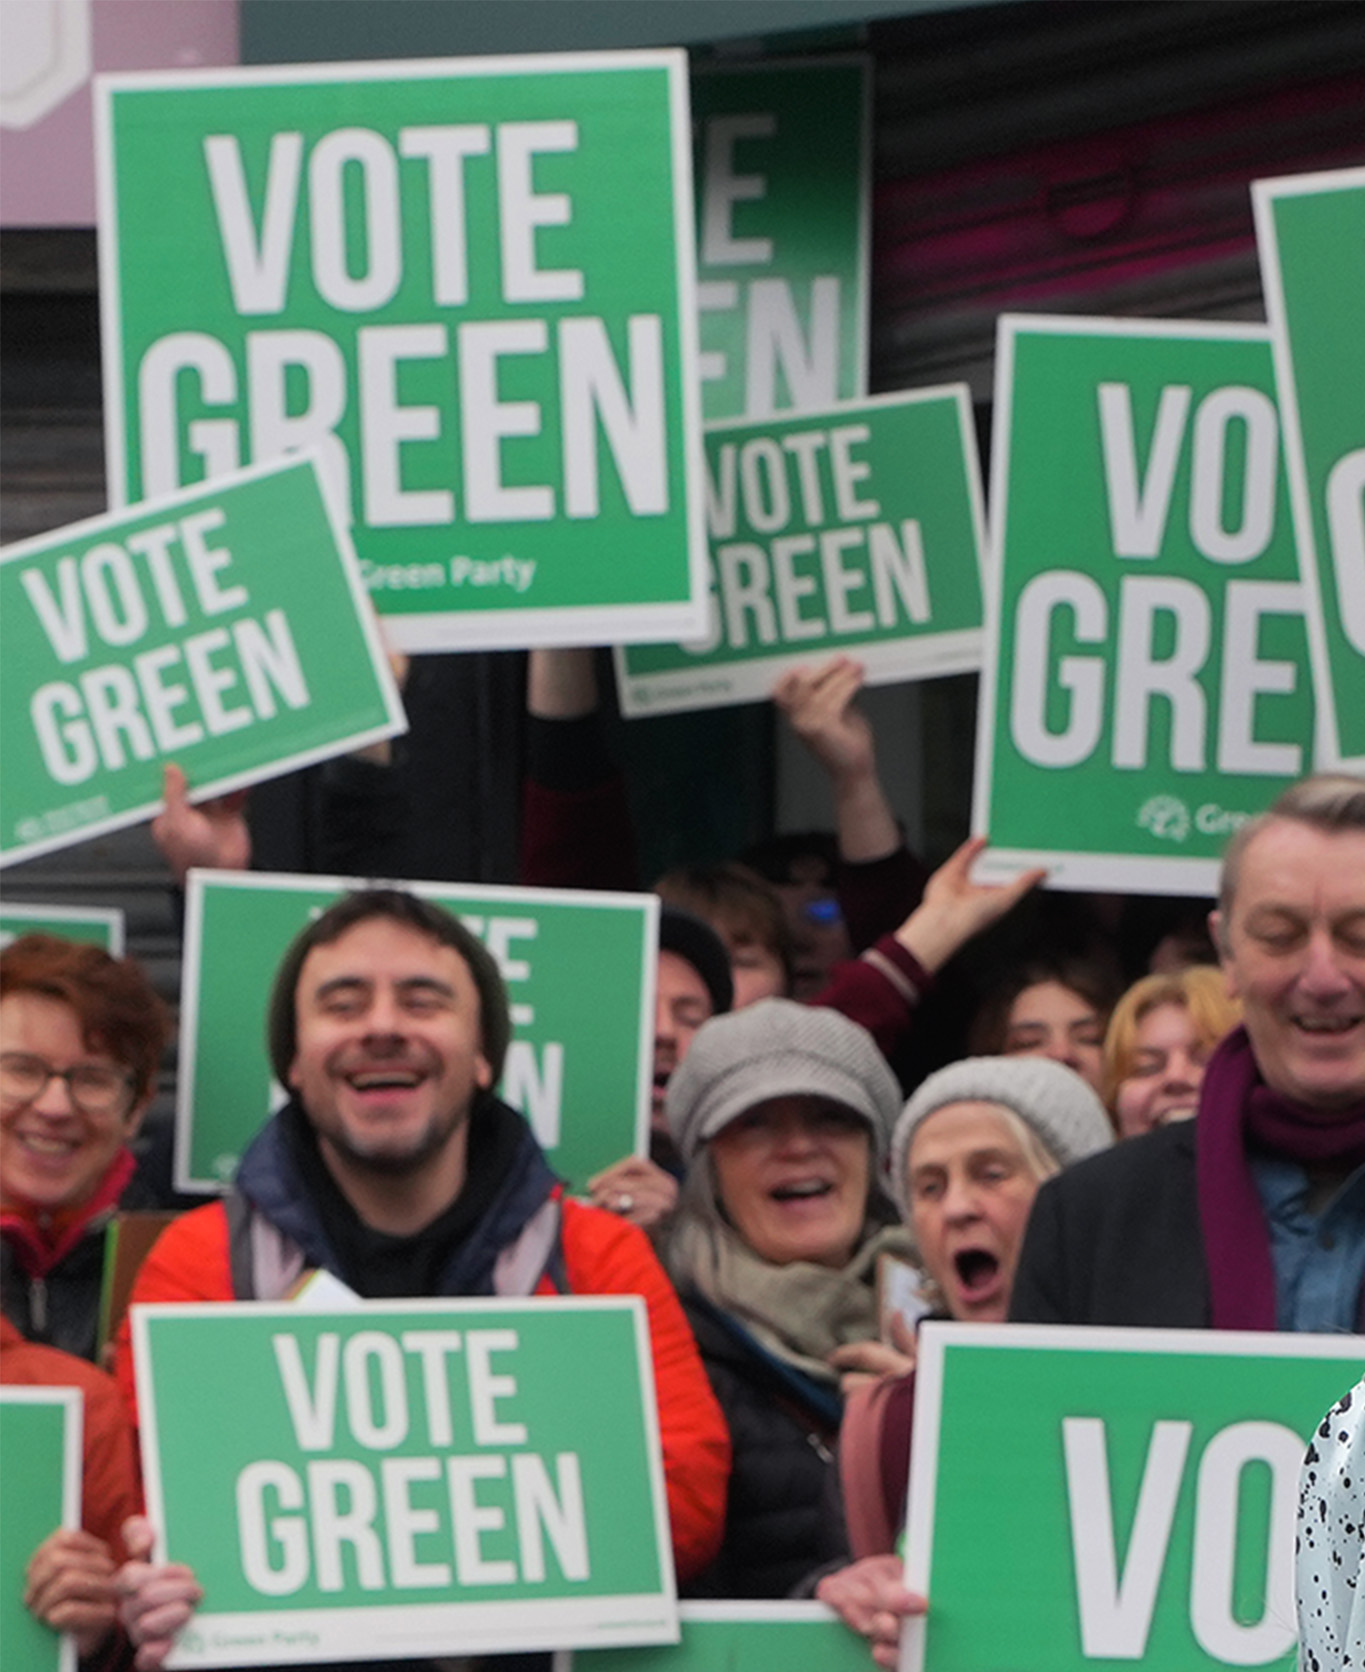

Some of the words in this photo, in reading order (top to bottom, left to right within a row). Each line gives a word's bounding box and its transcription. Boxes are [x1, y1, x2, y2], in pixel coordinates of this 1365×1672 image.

[204, 119, 585, 316] VOTE
[137, 314, 671, 528] GREEN
[20, 506, 249, 664] VOTE
[452, 554, 537, 594] Party
[29, 608, 311, 787] GREEN
[273, 1330, 528, 1453] VOTE
[235, 1453, 589, 1597] GREEN
